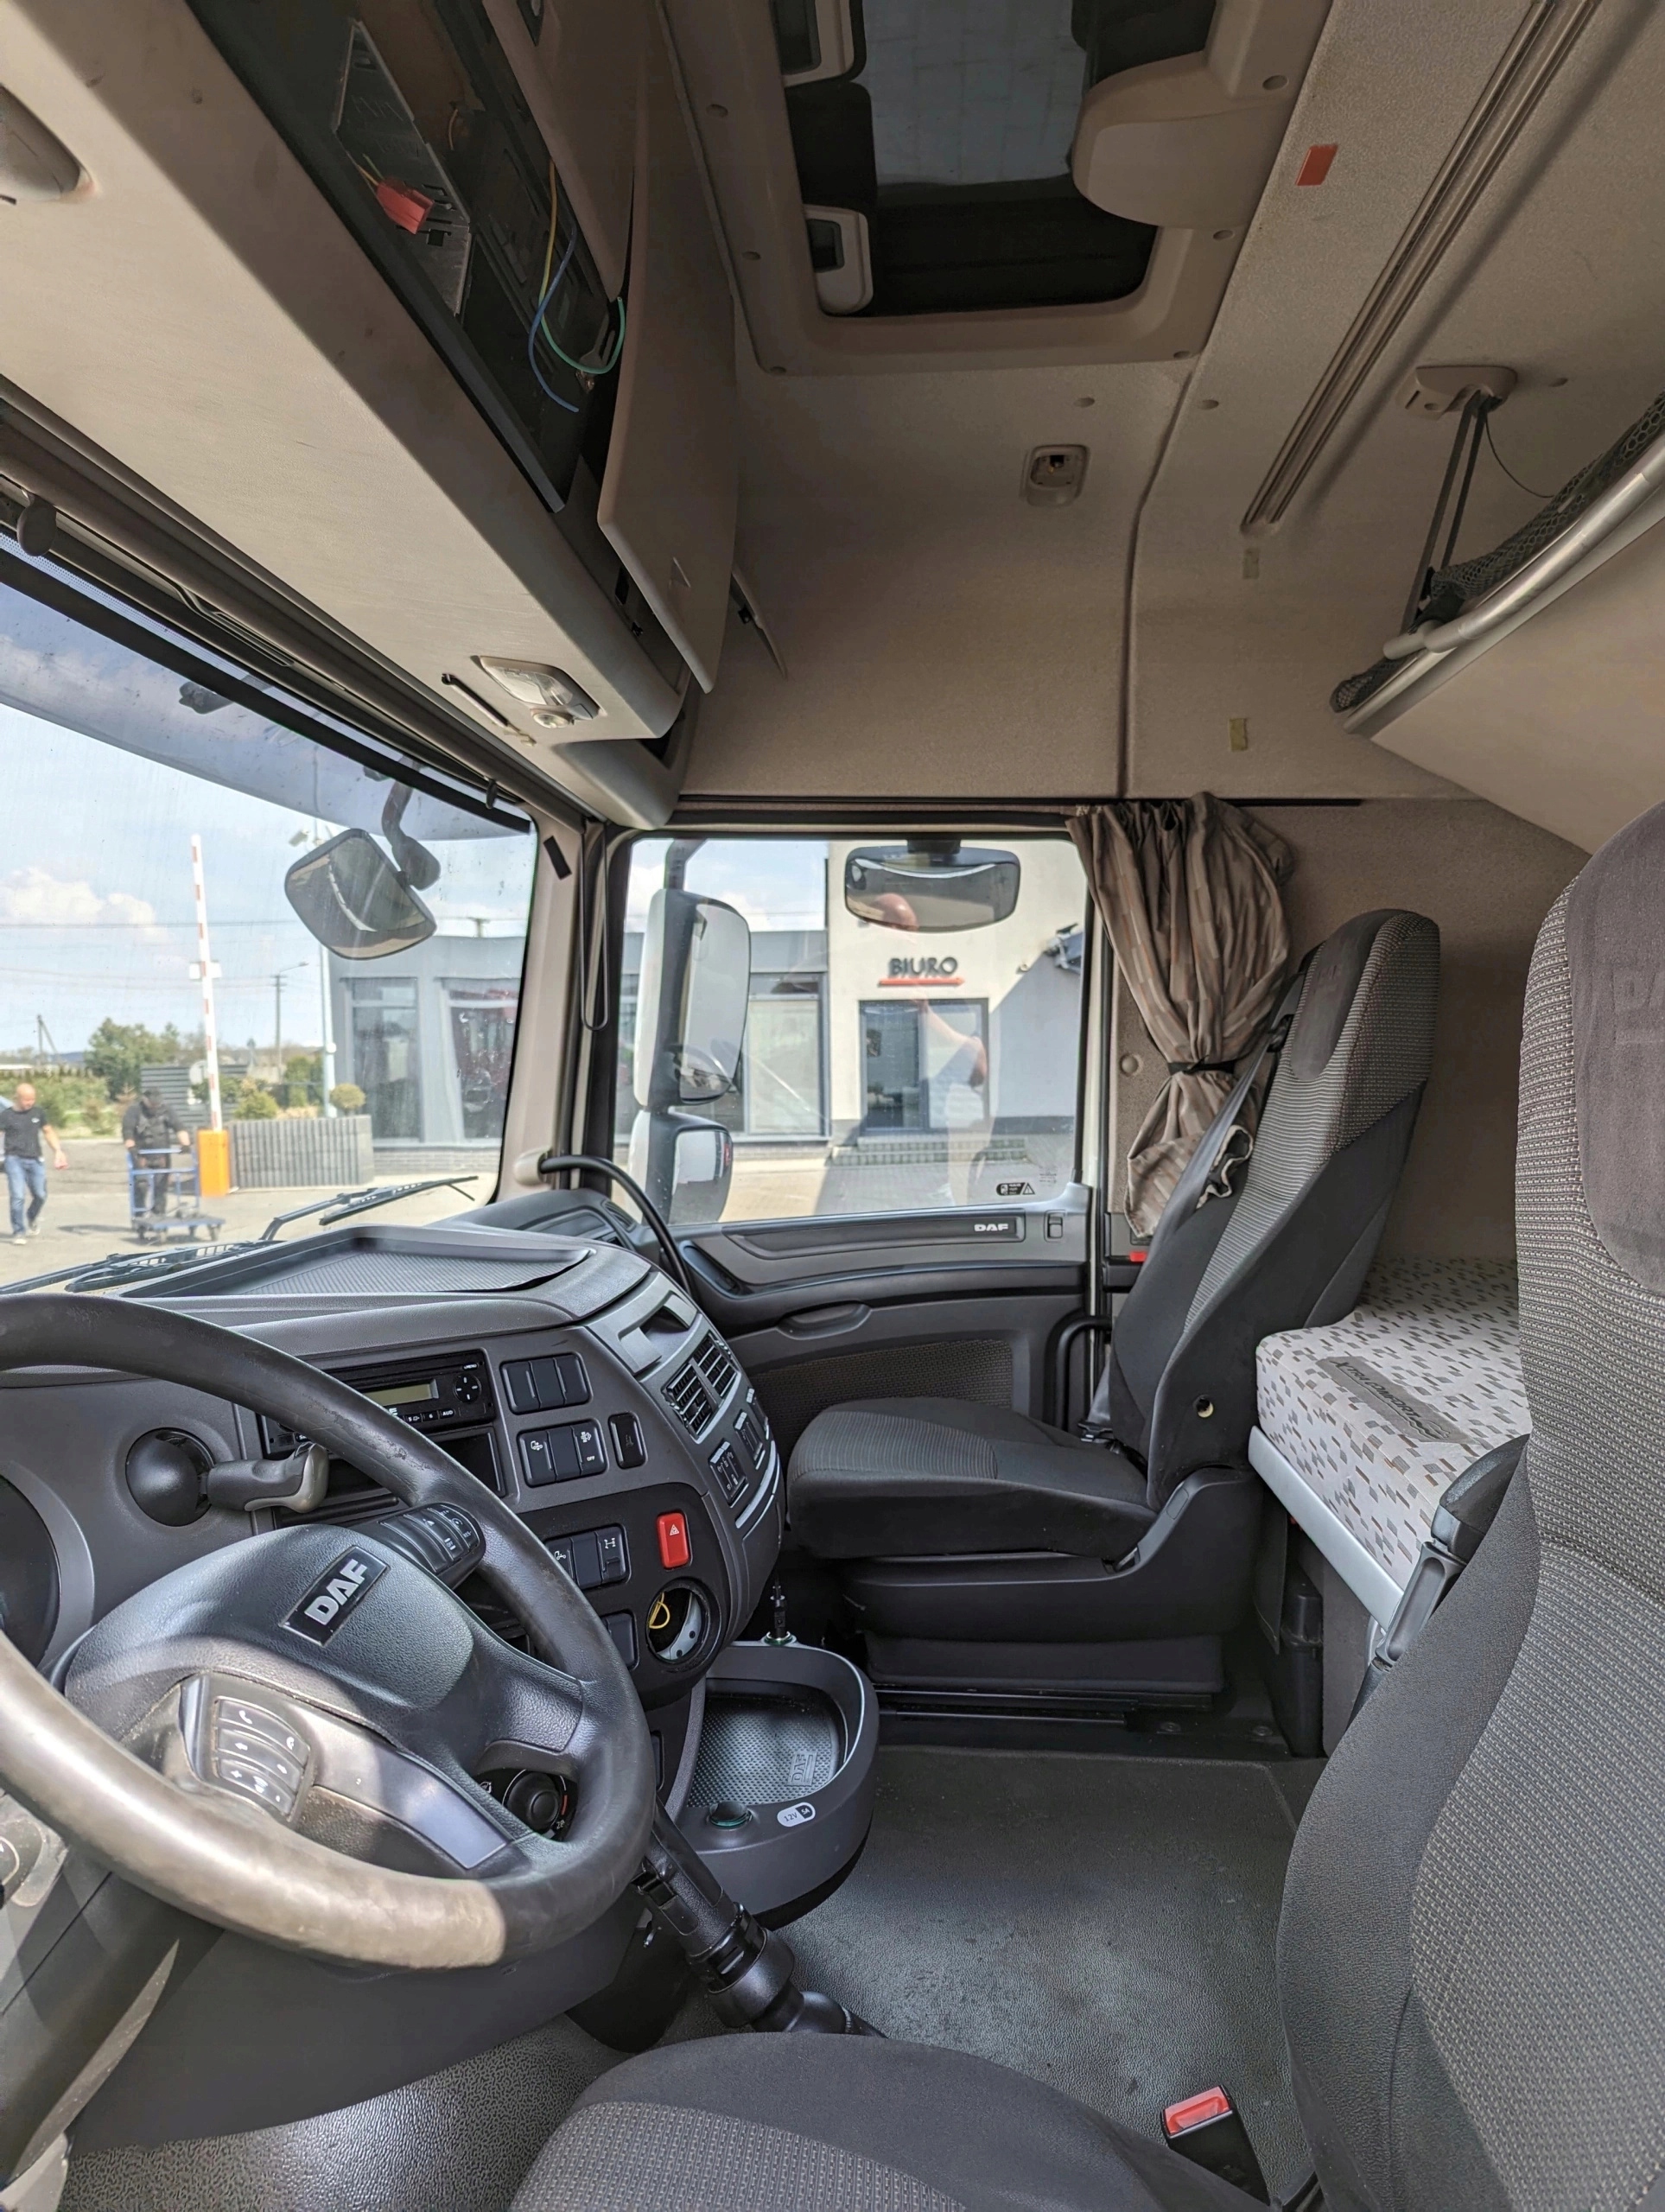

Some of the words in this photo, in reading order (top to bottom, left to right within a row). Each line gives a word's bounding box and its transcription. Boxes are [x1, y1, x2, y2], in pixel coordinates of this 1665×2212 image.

[888, 957, 958, 977] BIURO
[974, 1223, 1009, 1232] DAF
[1329, 1360, 1371, 1381] XTRA
[1364, 1381, 1422, 1419] COMFORT
[304, 1559, 368, 1625] DAF
[783, 1811, 799, 1822] 12V
